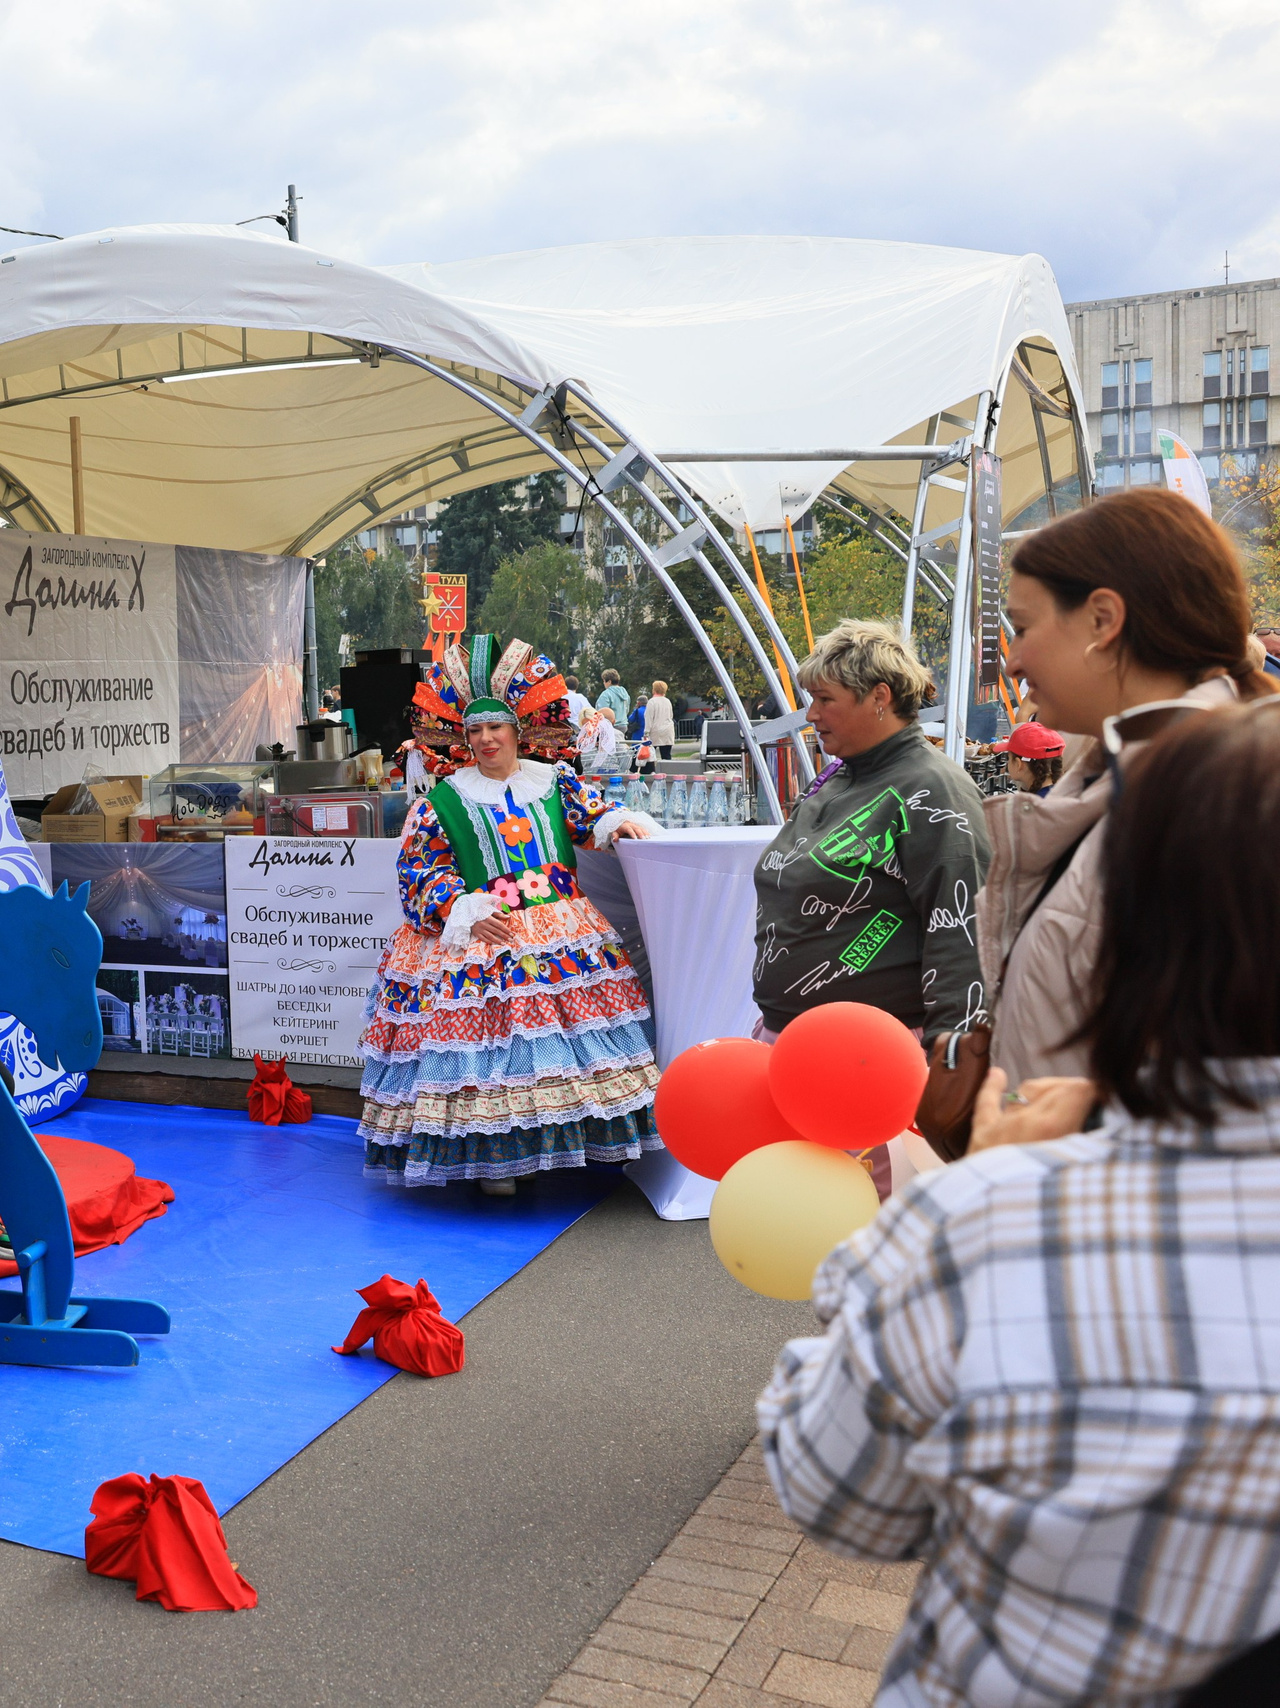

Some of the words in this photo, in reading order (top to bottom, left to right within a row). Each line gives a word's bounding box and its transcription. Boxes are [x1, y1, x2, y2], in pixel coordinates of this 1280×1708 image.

[42, 547, 90, 568] ЗАГОРОДНЫЙ
[92, 551, 129, 570] КОМПЛЕКС
[5, 546, 120, 636] Долина
[441, 576, 464, 585] ТУЛА
[10, 670, 153, 711] Обслуживание
[71, 726, 84, 750] и
[91, 722, 170, 755] торжеств
[273, 840, 311, 849] ЗАГОРОДНЫЙ
[249, 840, 334, 876] Долина
[245, 905, 373, 927] Обслуживание
[230, 930, 288, 947] свадеб
[293, 935, 303, 946] и
[308, 935, 388, 951] торжеств
[845, 920, 885, 962] NEVER
[853, 919, 895, 967] REGRET
[237, 981, 276, 993] ШАТРЫ
[279, 984, 296, 995] ДО
[299, 985, 316, 995] 140
[277, 1000, 331, 1013] БЕСЕДКИ
[272, 1016, 339, 1030] КЕЙТЕРИНГ
[280, 1033, 328, 1047] ФУРШЕТ
[300, 1051, 366, 1067] РЕГИСТРАЦ
